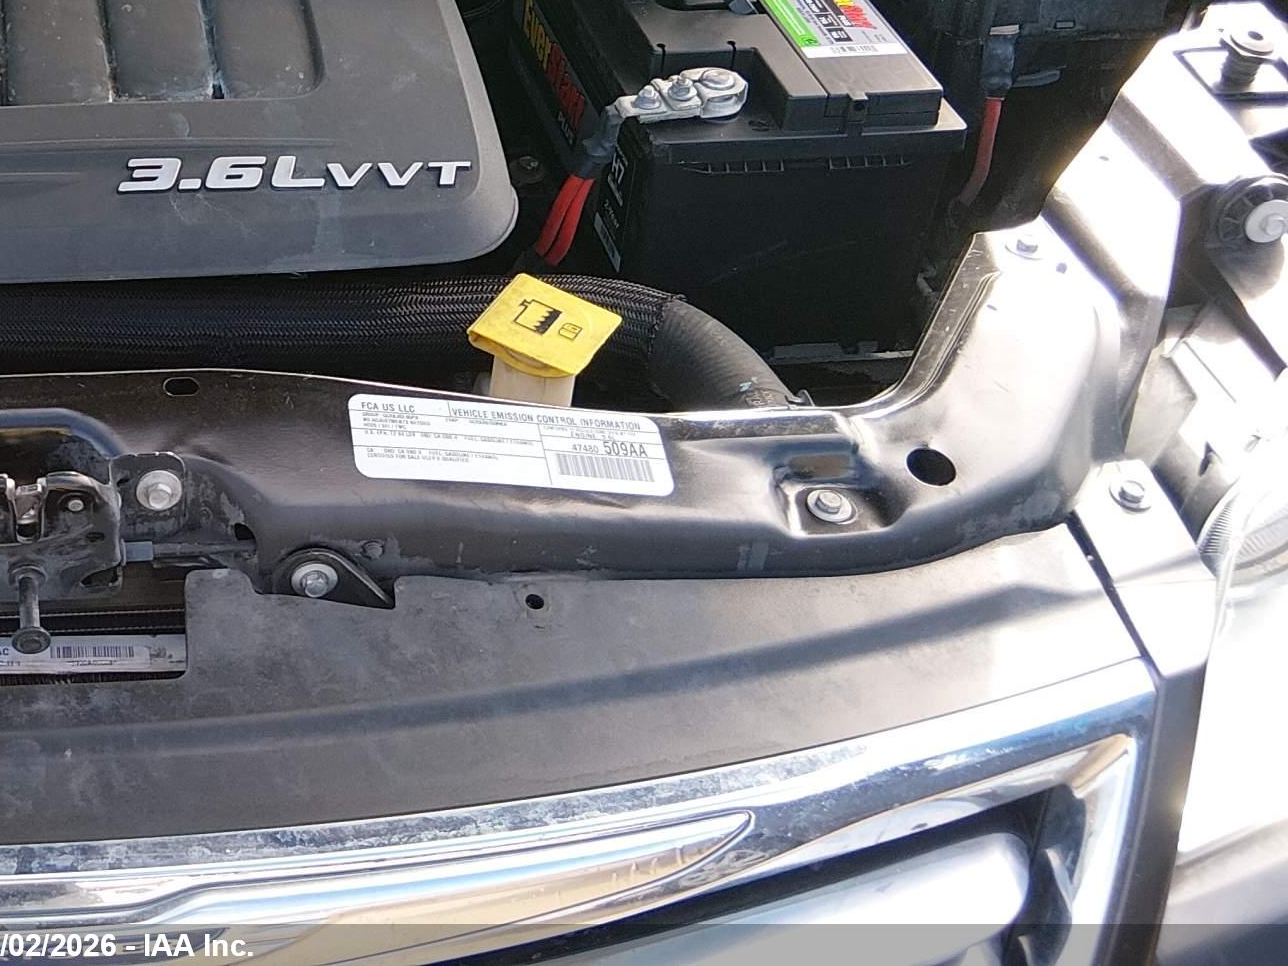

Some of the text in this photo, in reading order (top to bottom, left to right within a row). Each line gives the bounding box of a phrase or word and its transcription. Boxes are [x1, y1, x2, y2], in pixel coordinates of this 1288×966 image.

[118, 155, 472, 193] 3.6L VVT
[361, 401, 415, 413] FCA US LLC
[451, 407, 489, 419] VEHICLE
[492, 409, 534, 422] EMISSION
[537, 414, 577, 426] CONTROL
[580, 417, 641, 430] INFORMATION
[603, 441, 649, 458] 509AA
